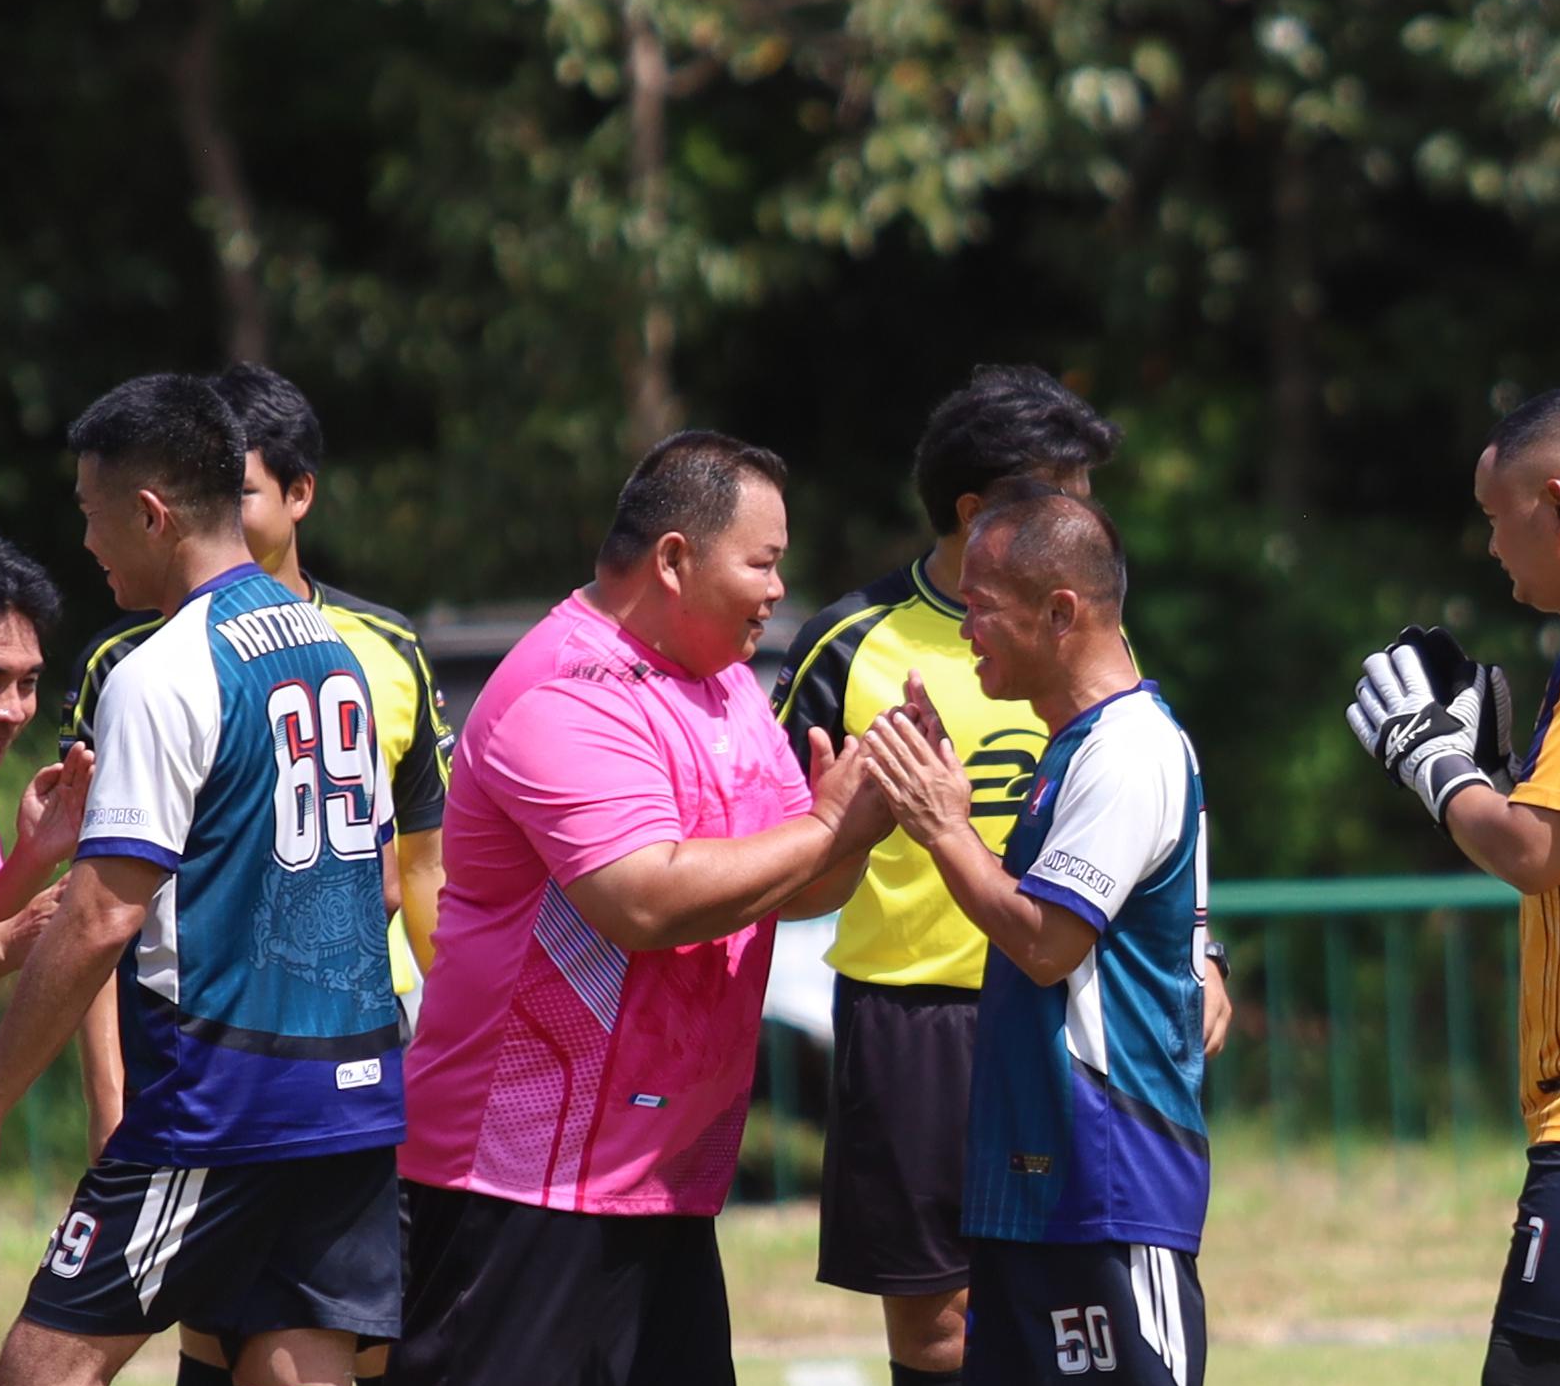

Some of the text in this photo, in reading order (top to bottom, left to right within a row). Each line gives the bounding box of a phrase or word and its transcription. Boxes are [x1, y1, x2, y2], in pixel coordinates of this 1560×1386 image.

[267, 671, 379, 871] 69
[1065, 855, 1116, 898] MAESOT
[1051, 1305, 1117, 1375] 50
